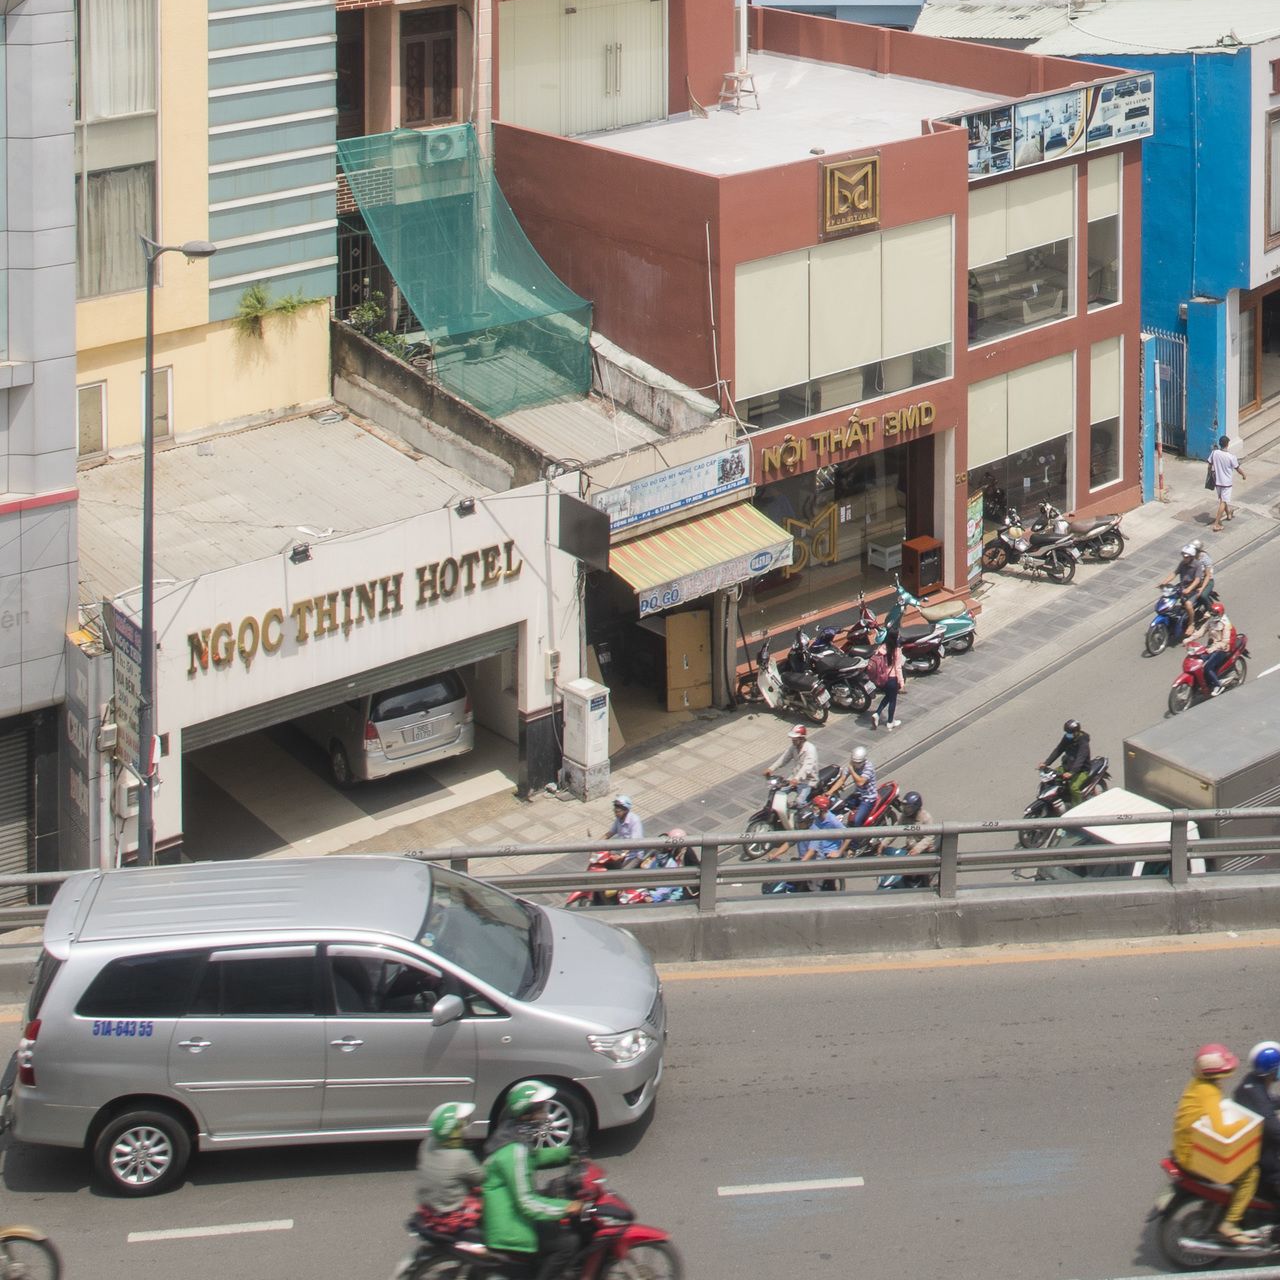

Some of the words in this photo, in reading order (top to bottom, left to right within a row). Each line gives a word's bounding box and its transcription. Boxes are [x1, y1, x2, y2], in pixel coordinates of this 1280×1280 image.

[762, 433, 807, 472] NỘI
[810, 407, 878, 457] THẤT
[187, 607, 285, 677] NGỌC
[291, 572, 405, 643] THỊNH
[415, 539, 524, 608] HOTEL
